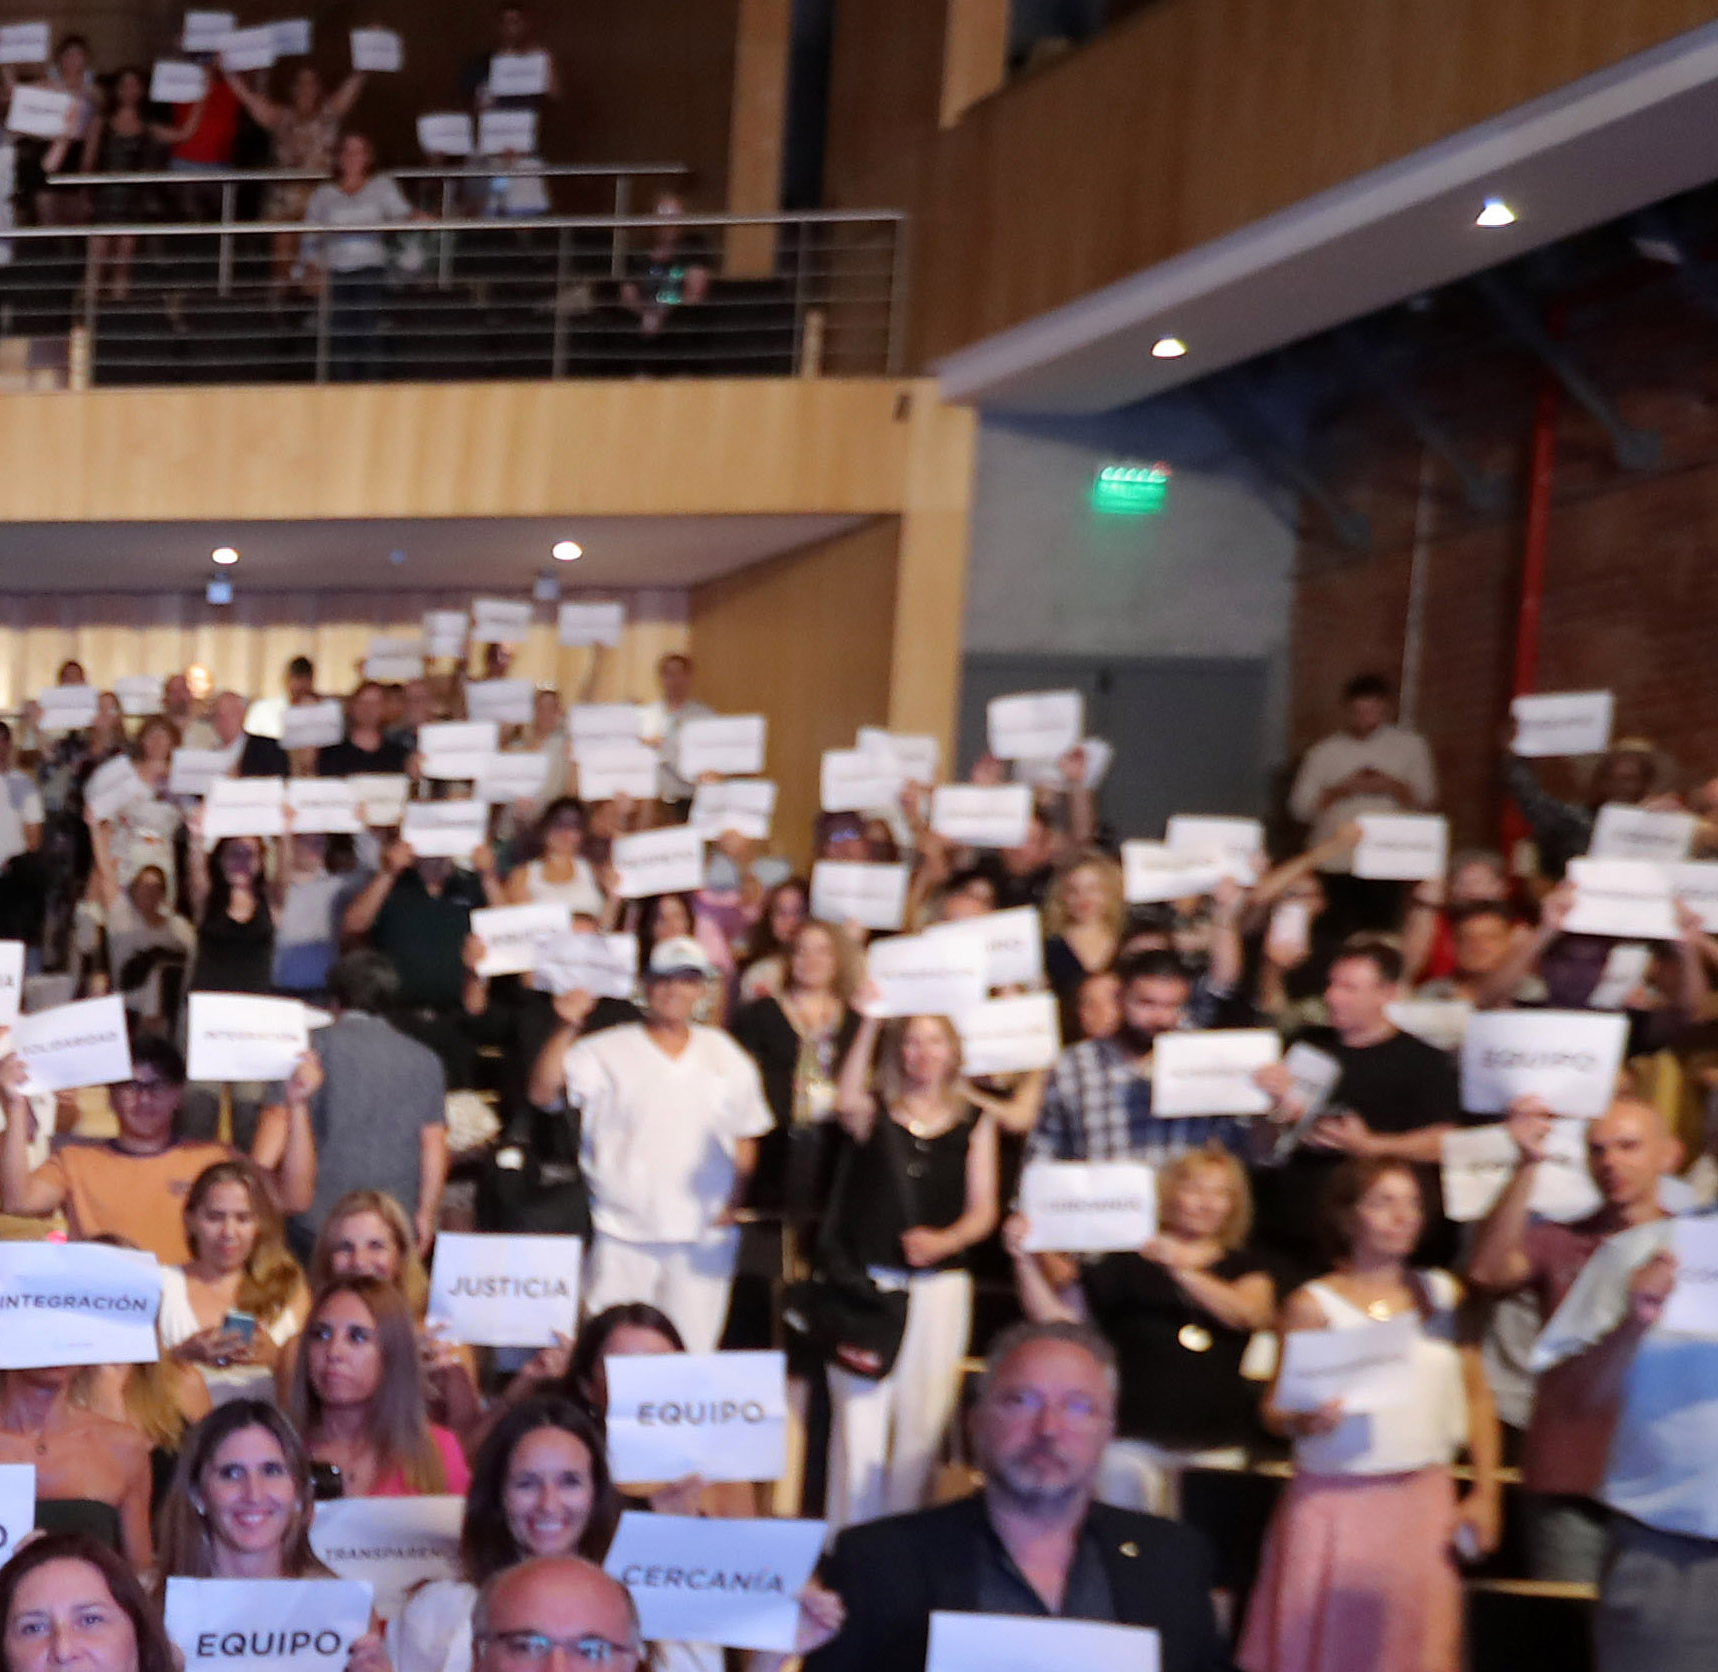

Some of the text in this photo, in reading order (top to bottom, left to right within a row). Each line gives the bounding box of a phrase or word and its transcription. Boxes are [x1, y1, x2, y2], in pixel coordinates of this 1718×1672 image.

[447, 1276, 570, 1298] JUSTICIA
[0, 1293, 148, 1313] INTEGRACIÓN
[637, 1401, 766, 1426] EQUIPO
[620, 1561, 785, 1595] CERCANÍA
[195, 1630, 342, 1659] EQUIPO
